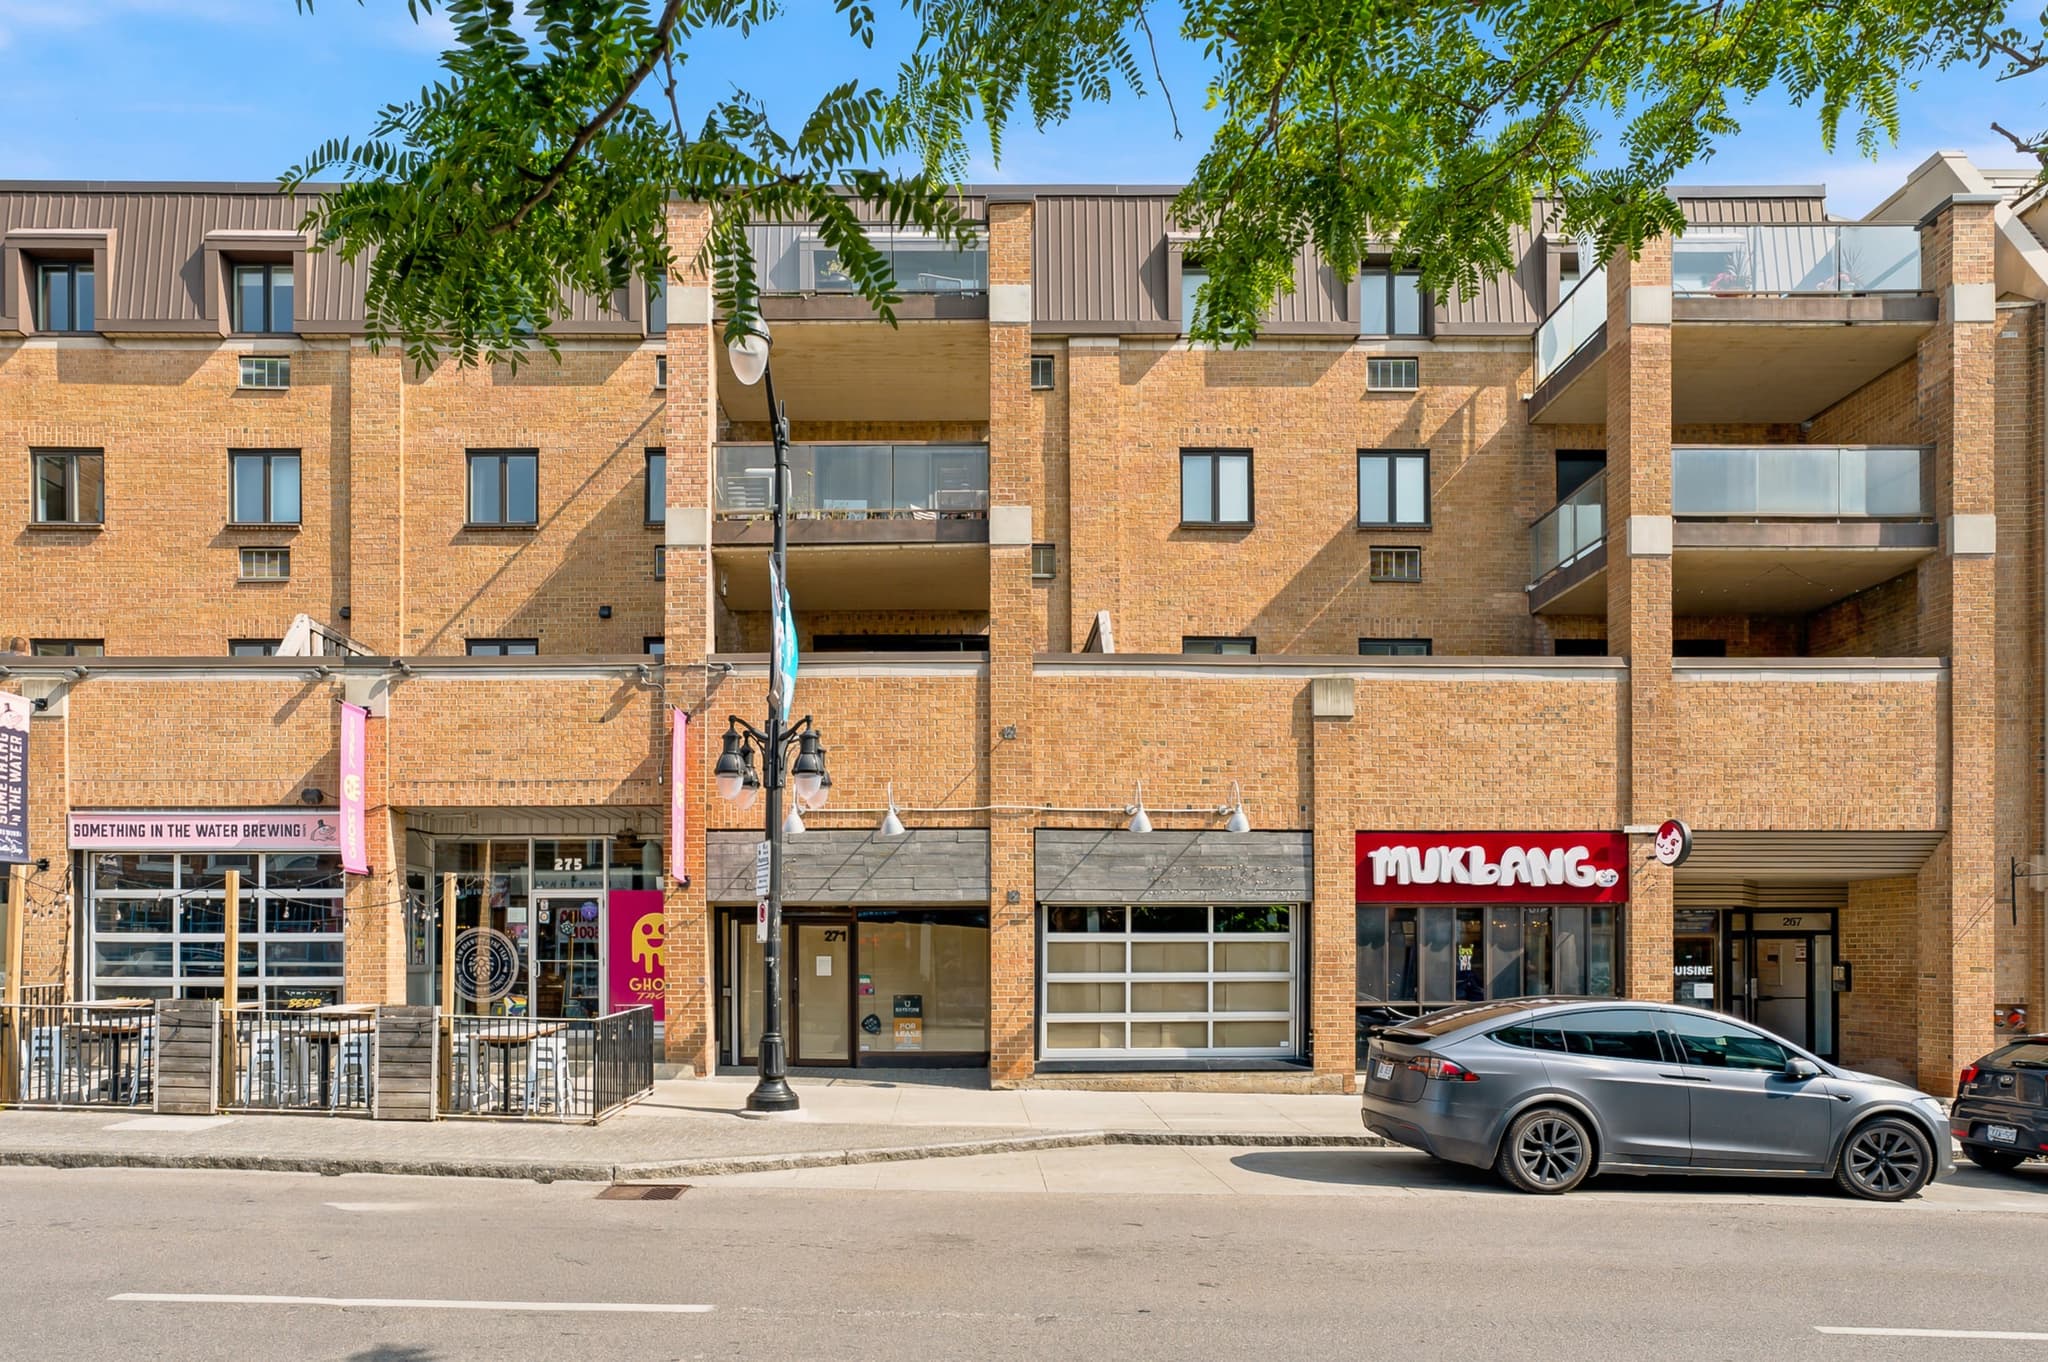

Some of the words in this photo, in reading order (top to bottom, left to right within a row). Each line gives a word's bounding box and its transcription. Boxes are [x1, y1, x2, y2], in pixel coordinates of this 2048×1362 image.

[9, 736, 23, 783] WATER
[9, 786, 22, 811] THE
[9, 815, 21, 826] IN
[73, 823, 147, 838] SOMETHING
[150, 823, 164, 838] IN
[167, 823, 191, 838] THE
[195, 823, 238, 838] WATER
[243, 823, 301, 838] BREWING
[554, 858, 583, 871] 275
[1782, 917, 1803, 927] 267
[824, 930, 847, 942] 271
[629, 977, 665, 991] GHO
[288, 998, 322, 1009] BEER
